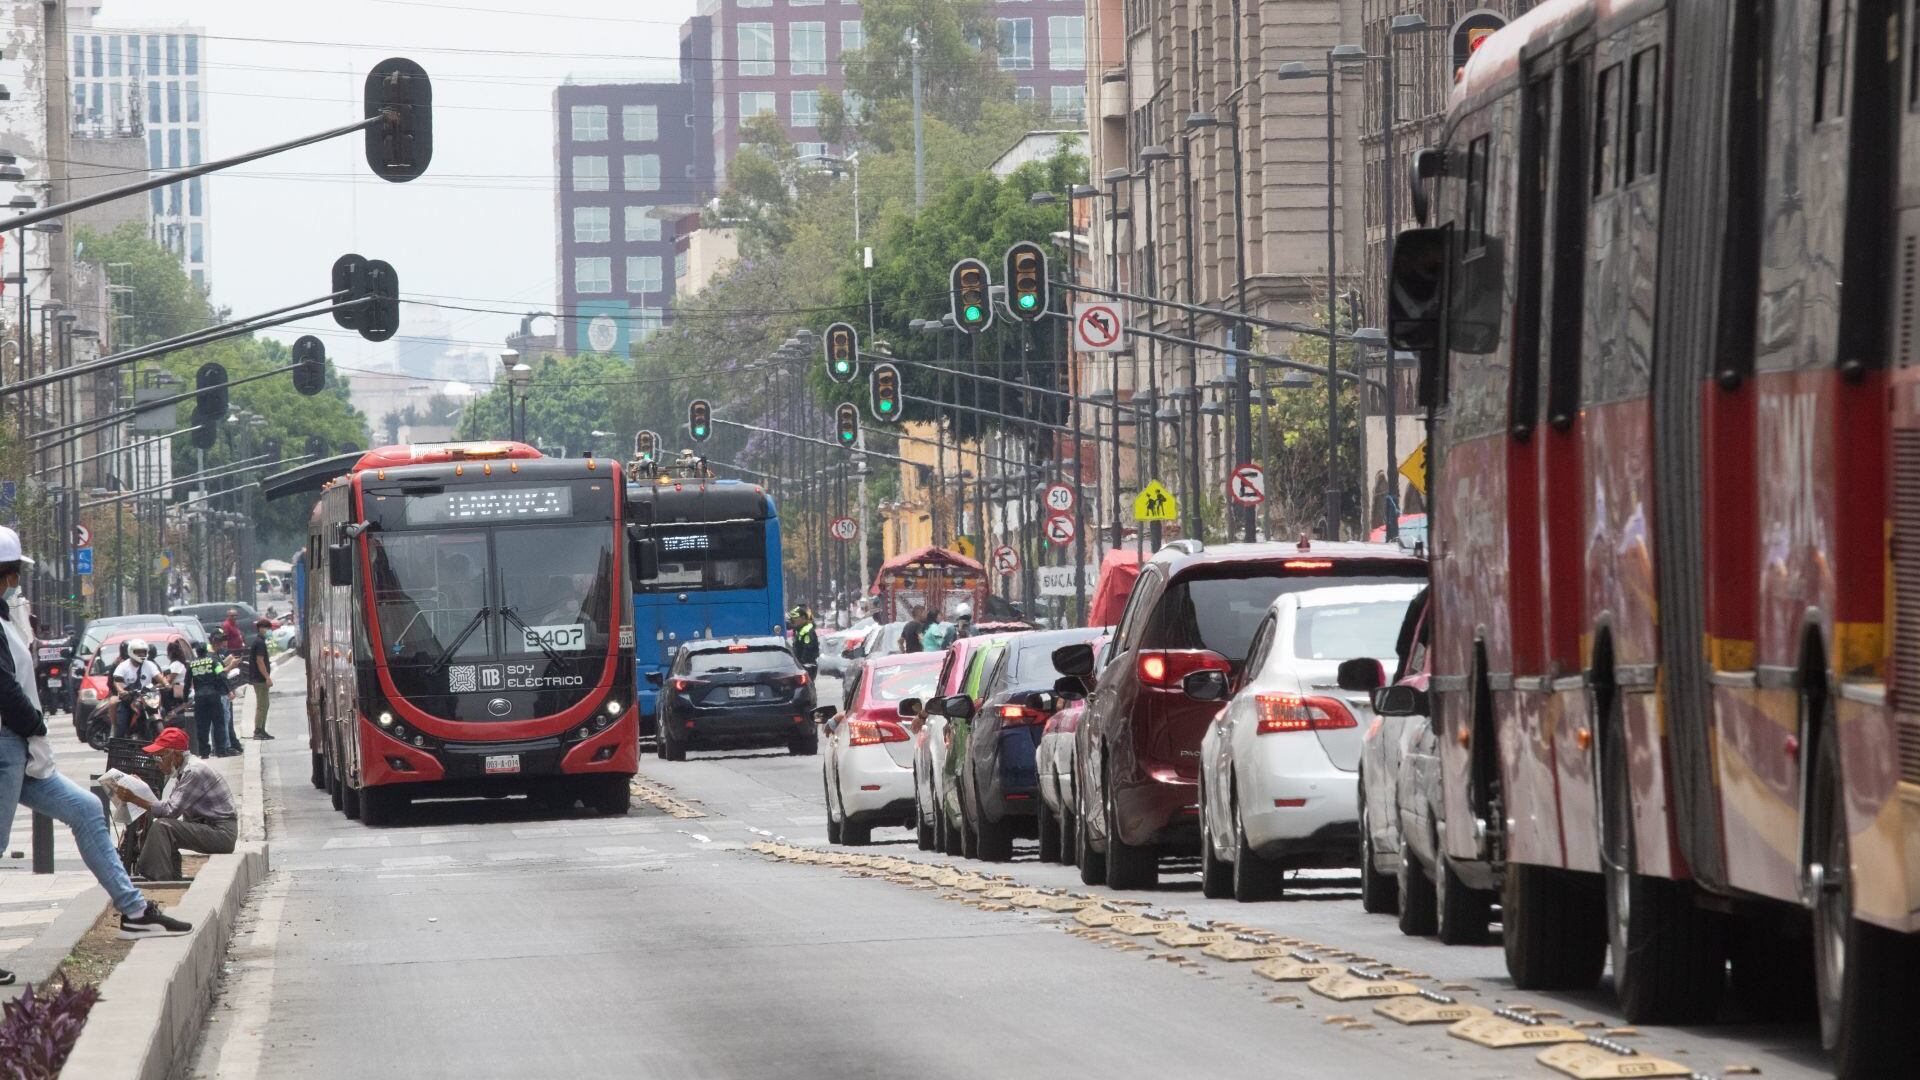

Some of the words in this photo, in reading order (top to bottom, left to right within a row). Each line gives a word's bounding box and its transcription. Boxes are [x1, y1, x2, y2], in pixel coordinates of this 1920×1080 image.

[1052, 490, 1068, 503] 50
[841, 521, 854, 534] 50
[525, 628, 583, 648] 9407
[507, 665, 534, 674] SOY
[507, 674, 583, 687] ELÉCTRICO
